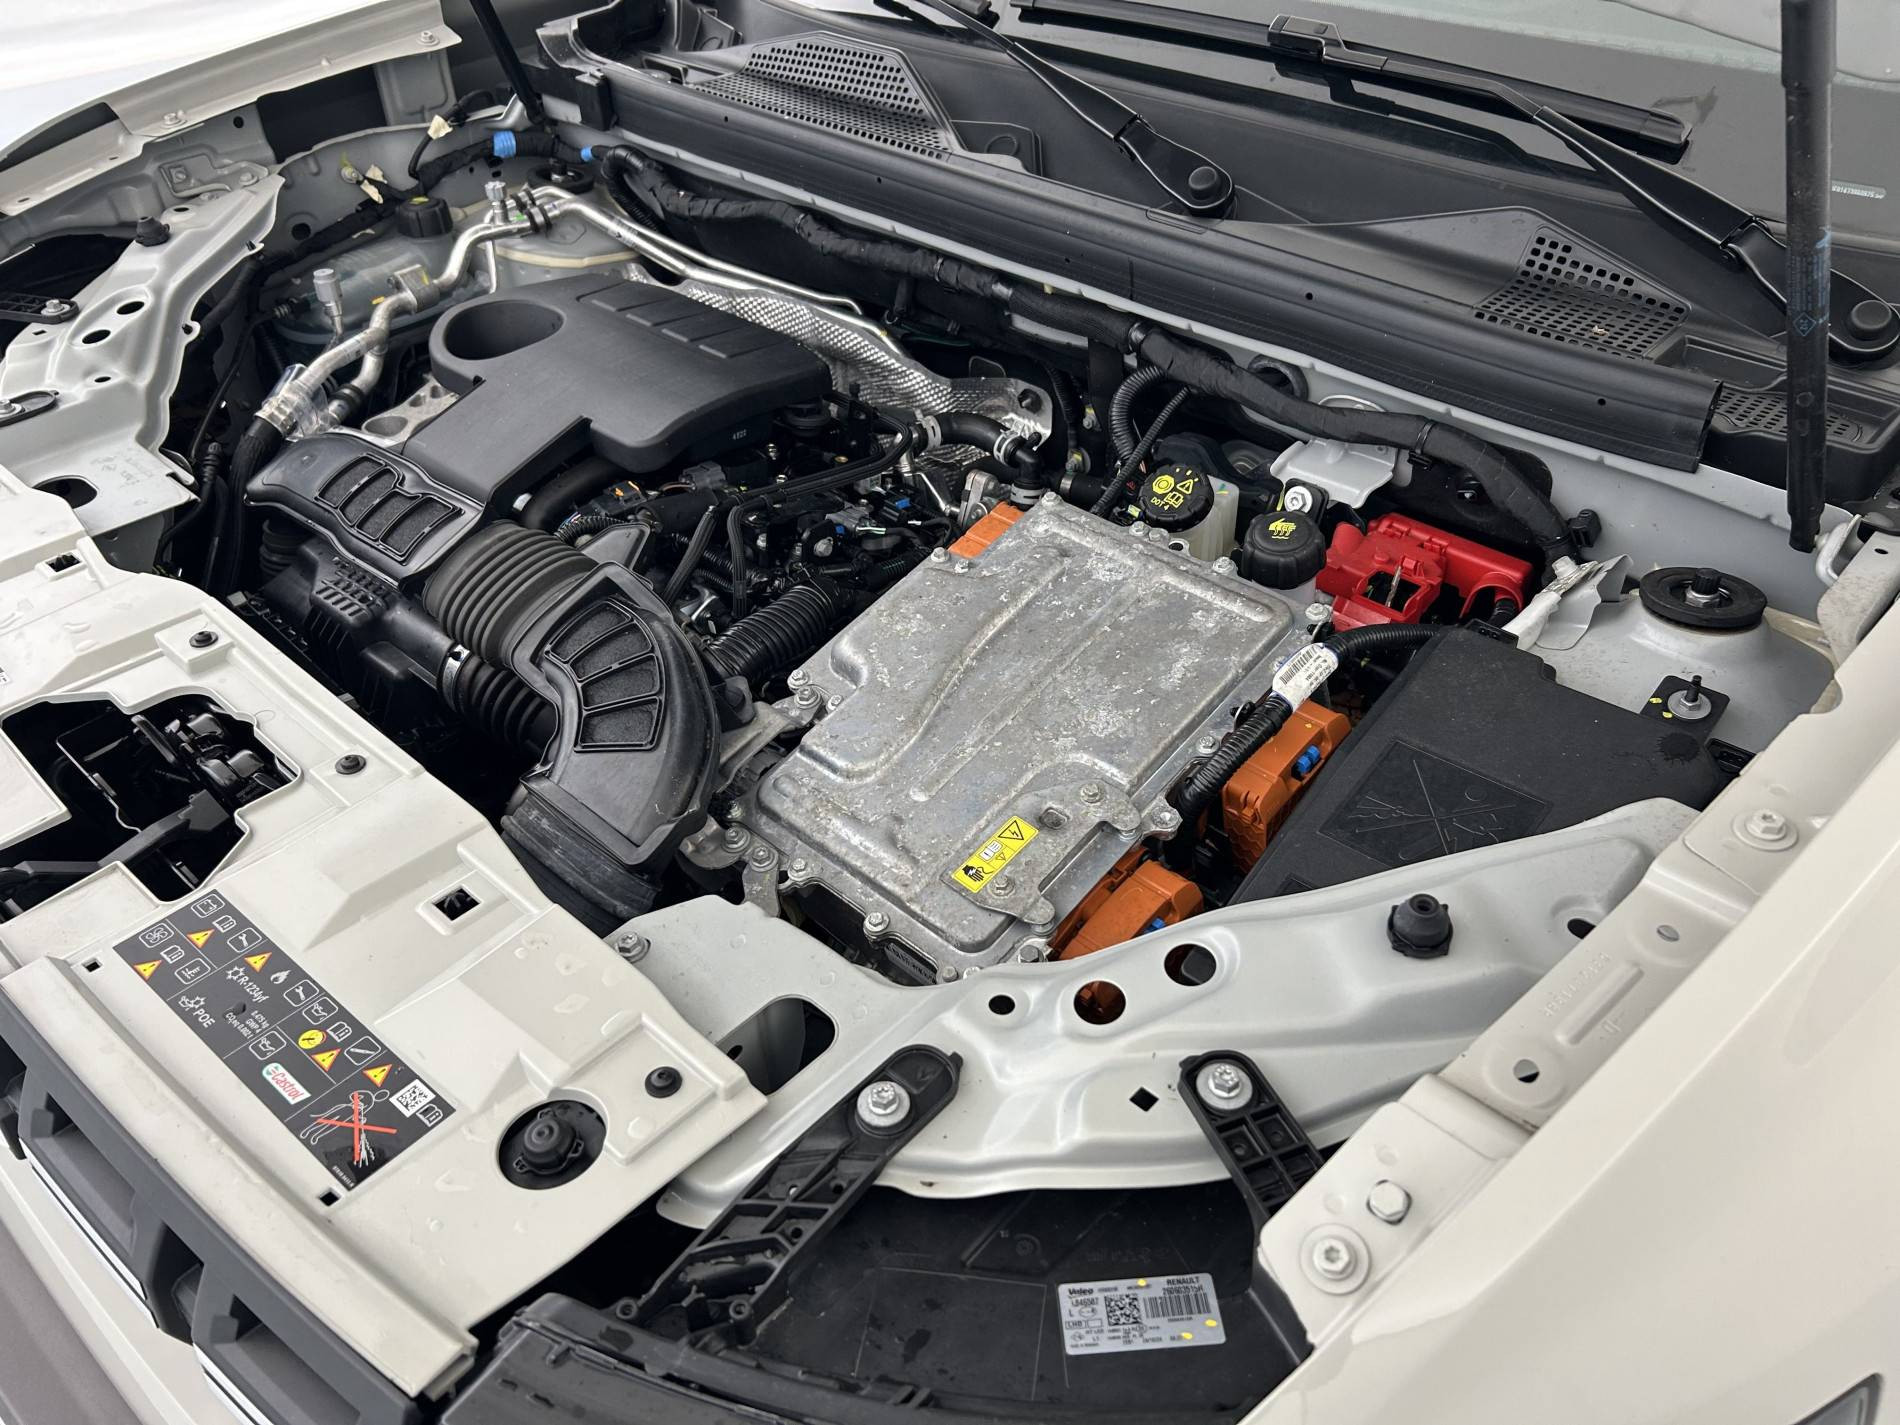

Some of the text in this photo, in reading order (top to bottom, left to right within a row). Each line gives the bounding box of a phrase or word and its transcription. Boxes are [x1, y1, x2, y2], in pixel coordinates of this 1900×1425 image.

[1151, 497, 1165, 507] DOT
[193, 1008, 216, 1028] POE
[271, 1071, 305, 1100] Castrol
[1166, 1276, 1200, 1286] RENAULT
[1068, 1288, 1094, 1296] Valeo
